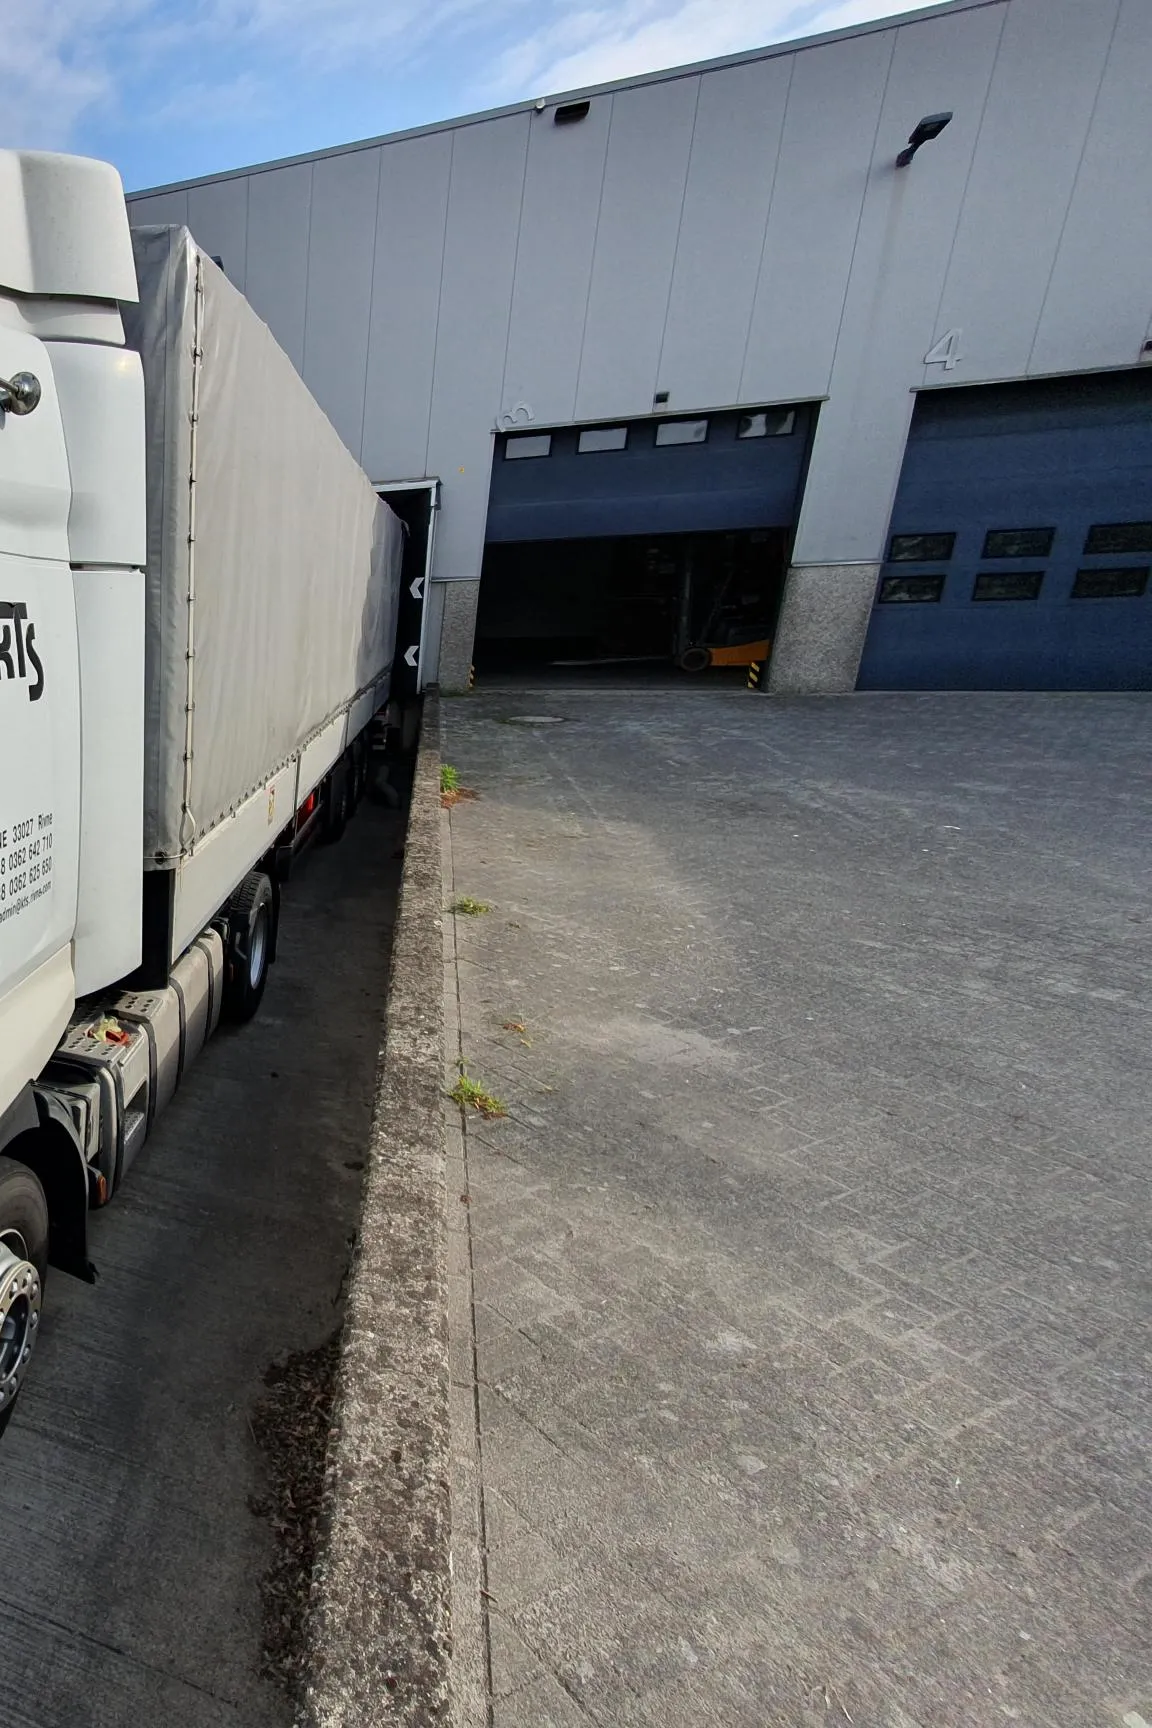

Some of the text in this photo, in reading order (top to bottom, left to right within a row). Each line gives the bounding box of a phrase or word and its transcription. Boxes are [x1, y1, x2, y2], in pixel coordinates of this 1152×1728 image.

[923, 328, 962, 371] 4
[12, 818, 34, 844] 33027
[8, 847, 27, 871] 0362
[28, 839, 40, 860] 642
[41, 832, 53, 852] 710
[9, 871, 27, 896] 0362
[29, 863, 41, 884] 625
